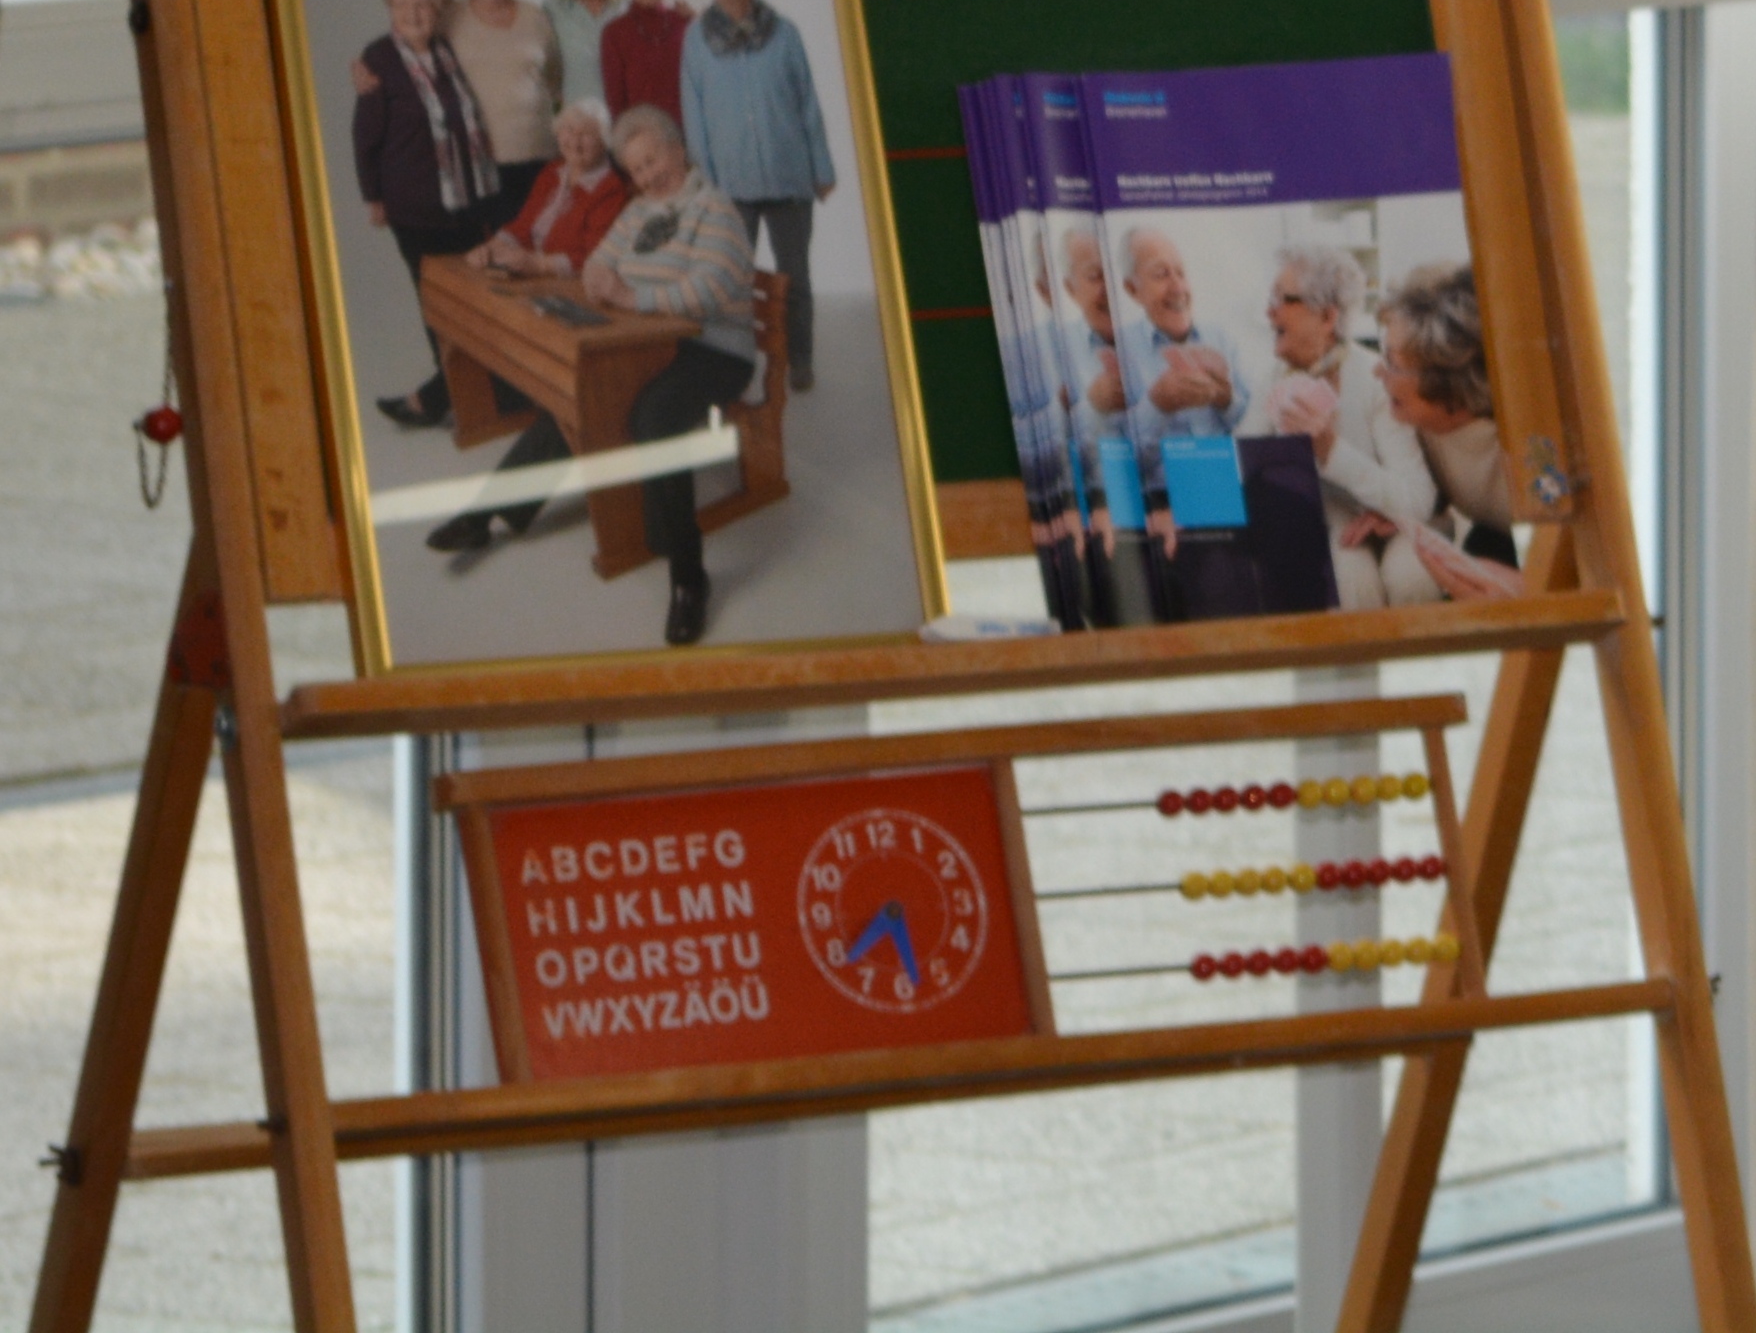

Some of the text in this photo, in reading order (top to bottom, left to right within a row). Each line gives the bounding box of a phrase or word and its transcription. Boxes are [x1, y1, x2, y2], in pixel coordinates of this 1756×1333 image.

[832, 830, 857, 860] 11
[866, 821, 896, 849] 12
[911, 828, 924, 852] 1
[520, 829, 747, 887] ABCDEFG
[937, 851, 957, 879] 2
[812, 865, 842, 892] 10
[526, 880, 755, 937] HIJKLMN
[812, 902, 832, 930] 9
[954, 888, 973, 916] 3
[950, 925, 971, 951] 4
[535, 932, 761, 989] OPQRSTU
[826, 939, 848, 967] 8
[857, 967, 876, 994] 7
[893, 973, 915, 1000] 6
[930, 959, 950, 986] 5
